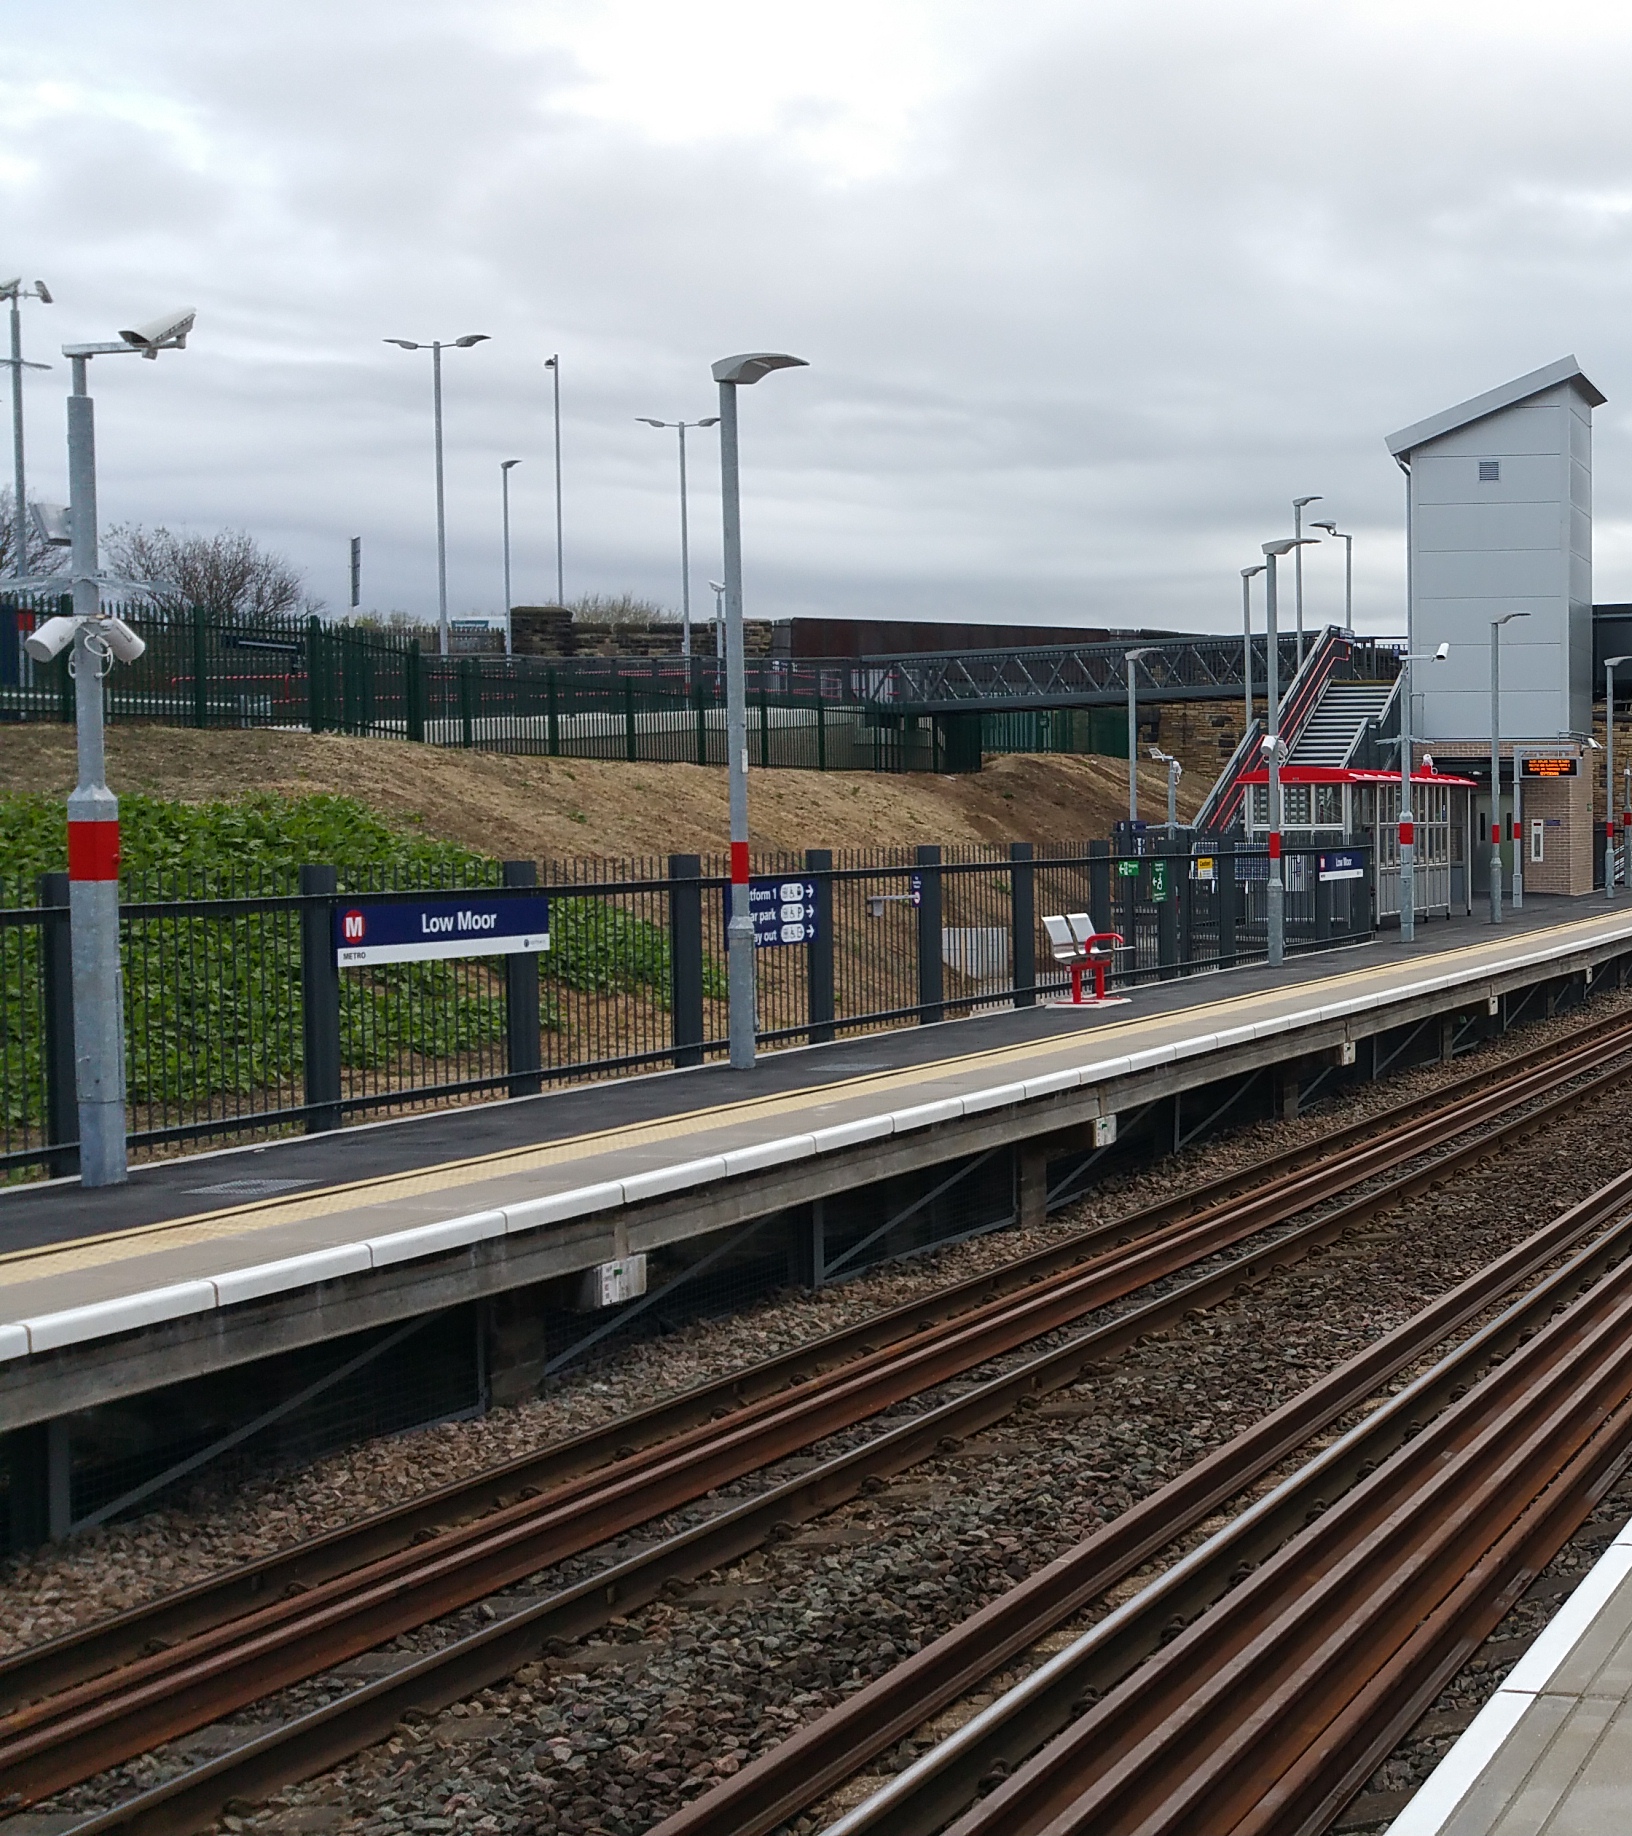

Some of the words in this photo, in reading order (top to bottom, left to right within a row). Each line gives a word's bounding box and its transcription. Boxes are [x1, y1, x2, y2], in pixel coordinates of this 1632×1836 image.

[772, 888, 777, 899] 1
[421, 914, 453, 933] Low
[457, 910, 497, 931] Moor
[750, 911, 758, 922] ar
[759, 908, 776, 924] park
[345, 916, 362, 937] M
[753, 932, 762, 945] ay
[764, 930, 777, 941] out
[343, 952, 366, 961] METRO
